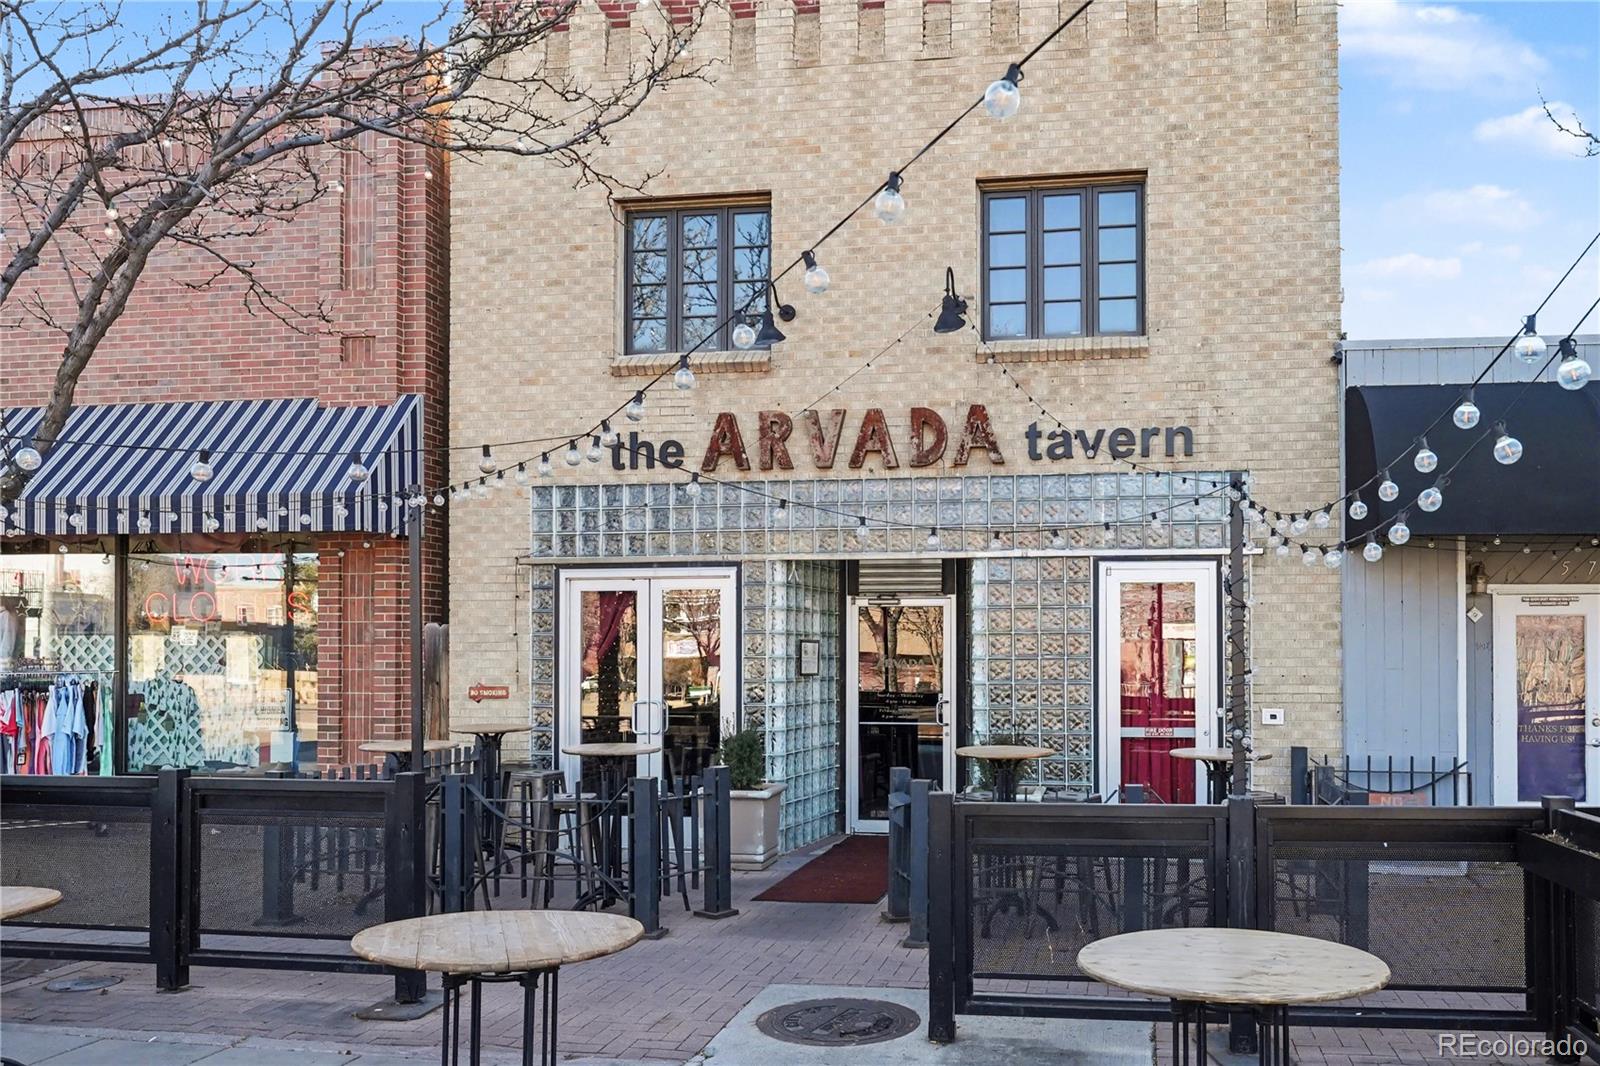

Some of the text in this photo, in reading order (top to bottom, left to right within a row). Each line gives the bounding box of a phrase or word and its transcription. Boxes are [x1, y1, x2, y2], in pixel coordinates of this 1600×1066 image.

[609, 403, 1194, 472] the ARVADA tavern
[1519, 724, 1577, 733] THANKS FOR
[1521, 735, 1576, 744] HAVING US!
